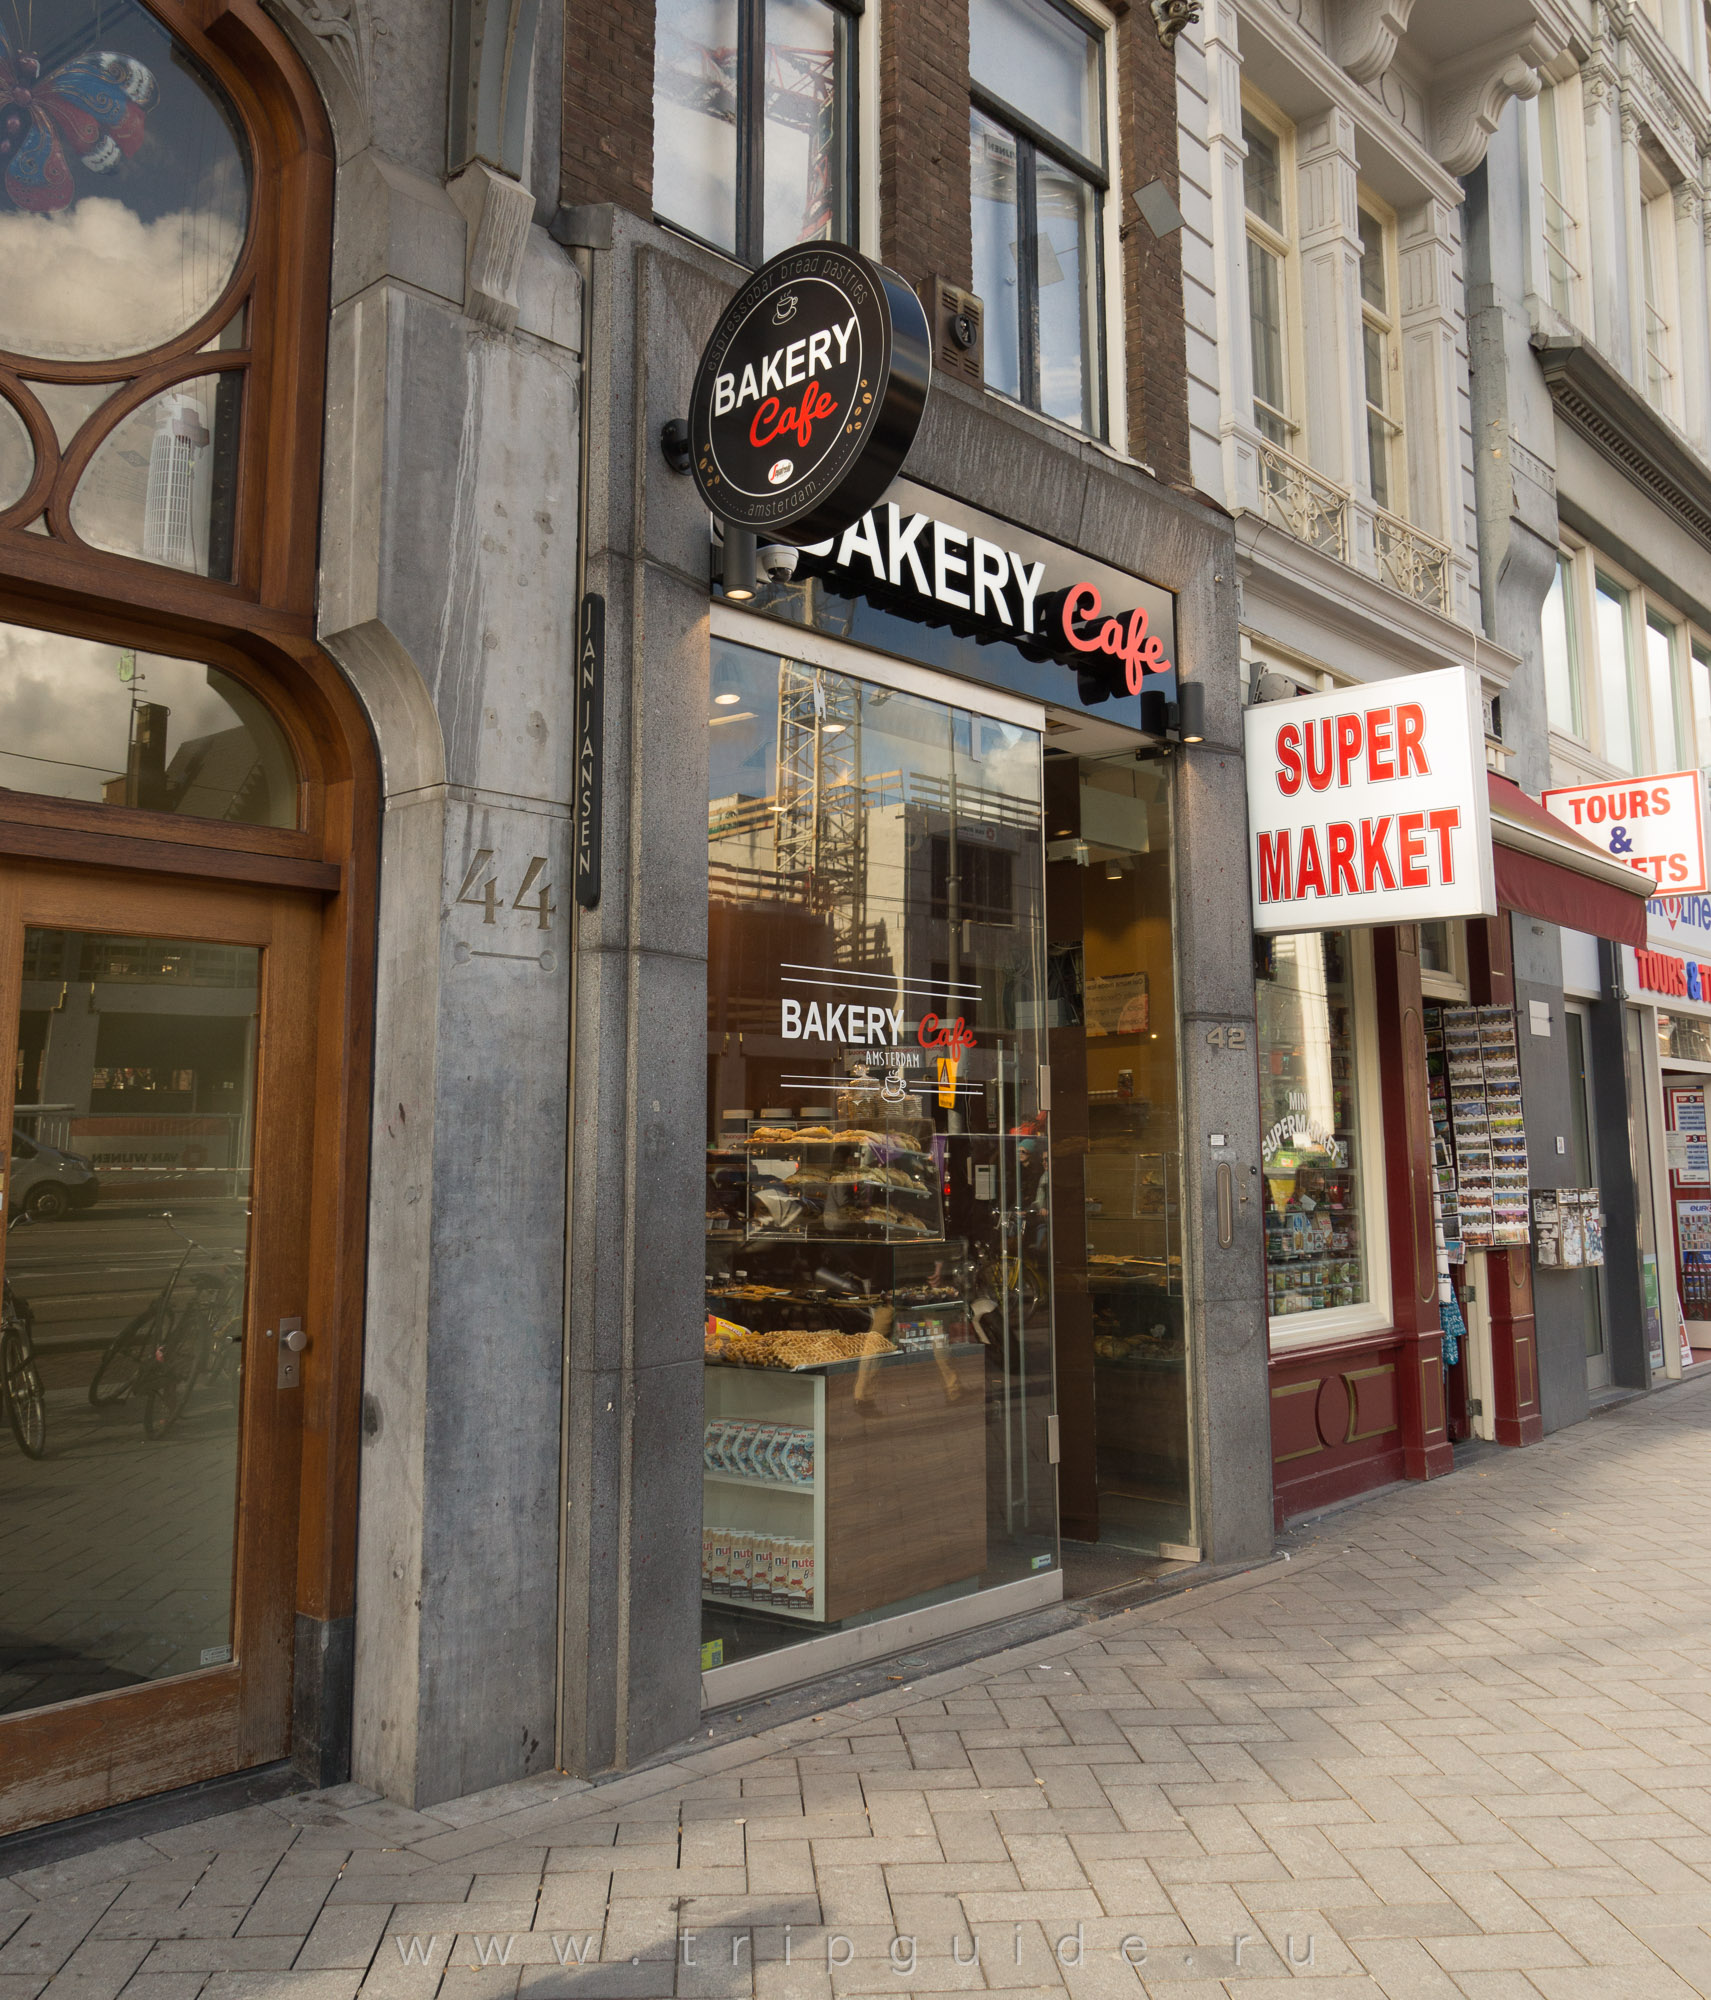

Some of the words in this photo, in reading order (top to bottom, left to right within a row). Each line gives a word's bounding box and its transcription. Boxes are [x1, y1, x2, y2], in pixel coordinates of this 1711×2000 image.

[707, 273, 775, 372] espressobar
[781, 255, 820, 279] bread
[821, 258, 869, 306] pastries
[714, 315, 857, 418] BAKERY
[749, 380, 839, 448] Cafe
[747, 480, 817, 517] amsterdam
[798, 501, 1046, 635] AKERY
[1061, 581, 1172, 696] Cafe
[582, 603, 596, 689] JAN
[1275, 701, 1432, 797] SUPER
[579, 700, 595, 876] JANSEN
[1568, 787, 1671, 825] TOURS
[1256, 805, 1461, 905] MARKET
[1609, 826, 1634, 855] &
[1622, 853, 1689, 883] ETS
[455, 848, 557, 930] 44
[1634, 947, 1688, 997] TOURS
[1686, 961, 1702, 1001] &
[1698, 964, 1711, 1003] T
[781, 998, 904, 1046] BAKERY
[917, 1012, 978, 1063] Cafe
[865, 1050, 920, 1069] AMSTERDAM
[1206, 1026, 1246, 1050] 42
[1261, 1113, 1340, 1162] SUPERMARKET
